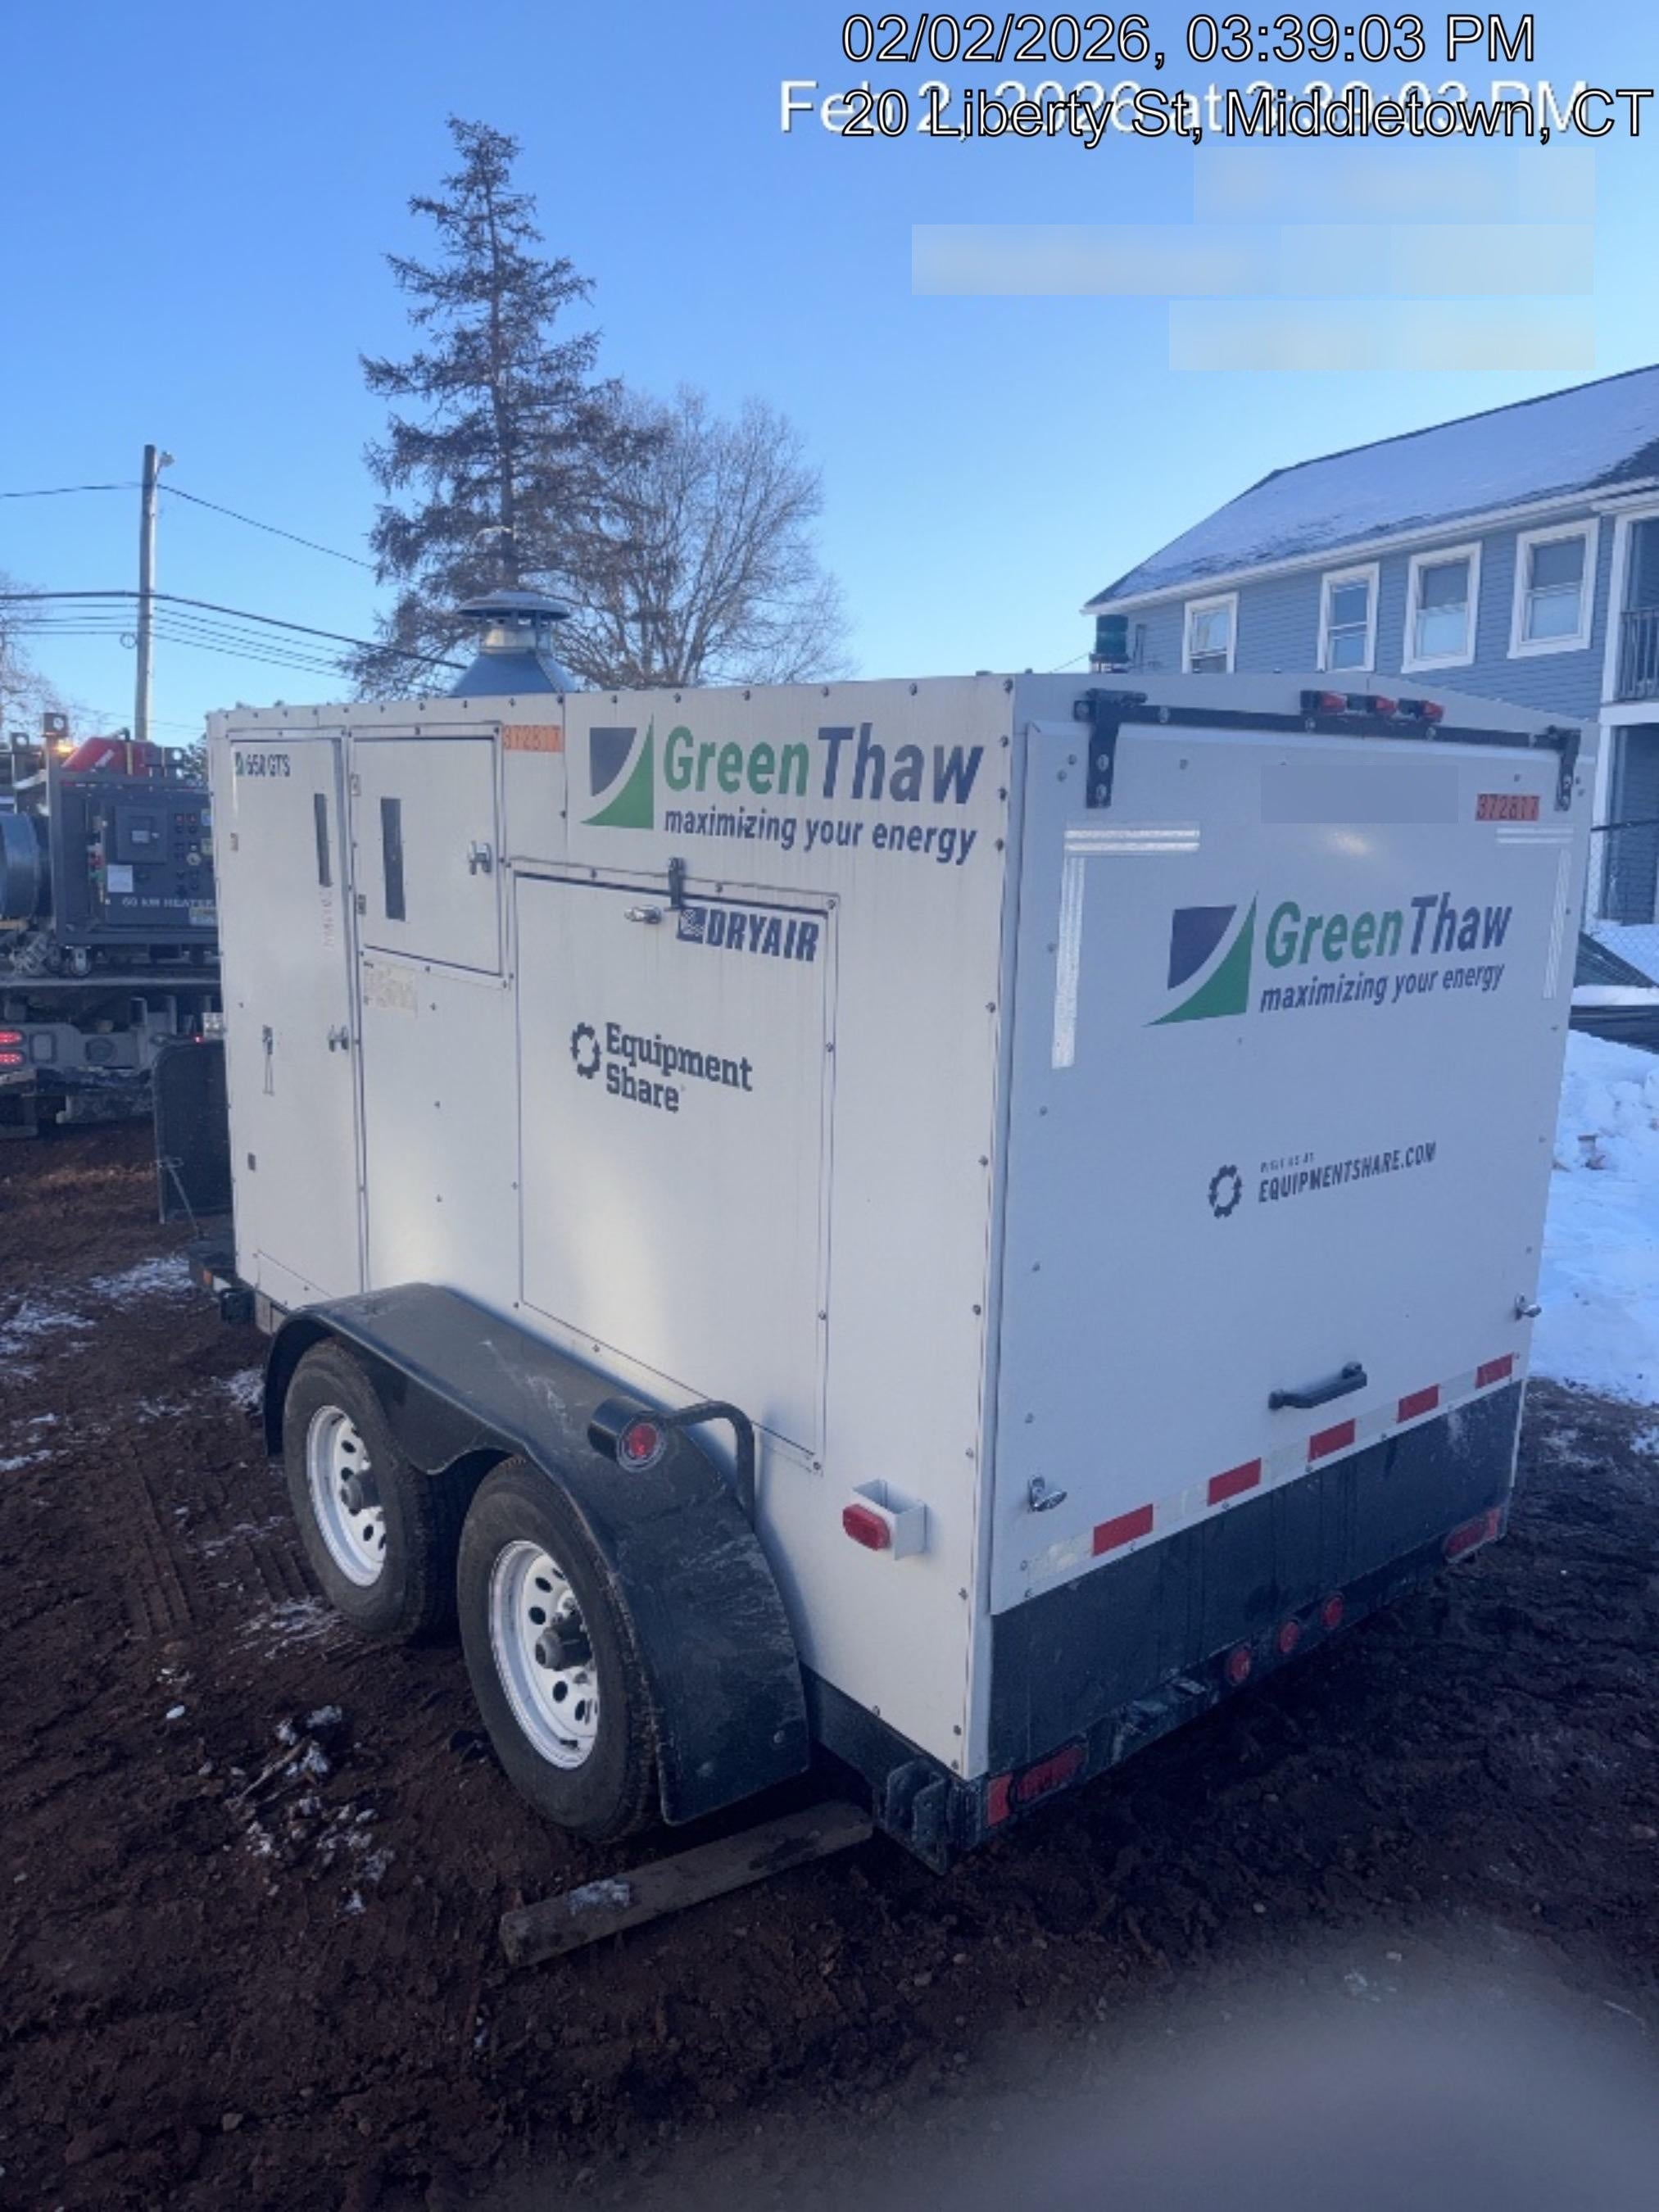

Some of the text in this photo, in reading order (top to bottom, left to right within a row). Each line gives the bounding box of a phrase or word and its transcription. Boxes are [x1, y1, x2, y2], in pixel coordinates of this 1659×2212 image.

[664, 805, 977, 866] maximizing your energy
[705, 909, 820, 963] DRYAIR
[1260, 963, 1504, 1013] maximizing your energy
[605, 1022, 754, 1092] Equipment
[605, 1063, 680, 1113] Share
[1258, 1140, 1437, 1203] EQUIPMENTSHARE.COM
